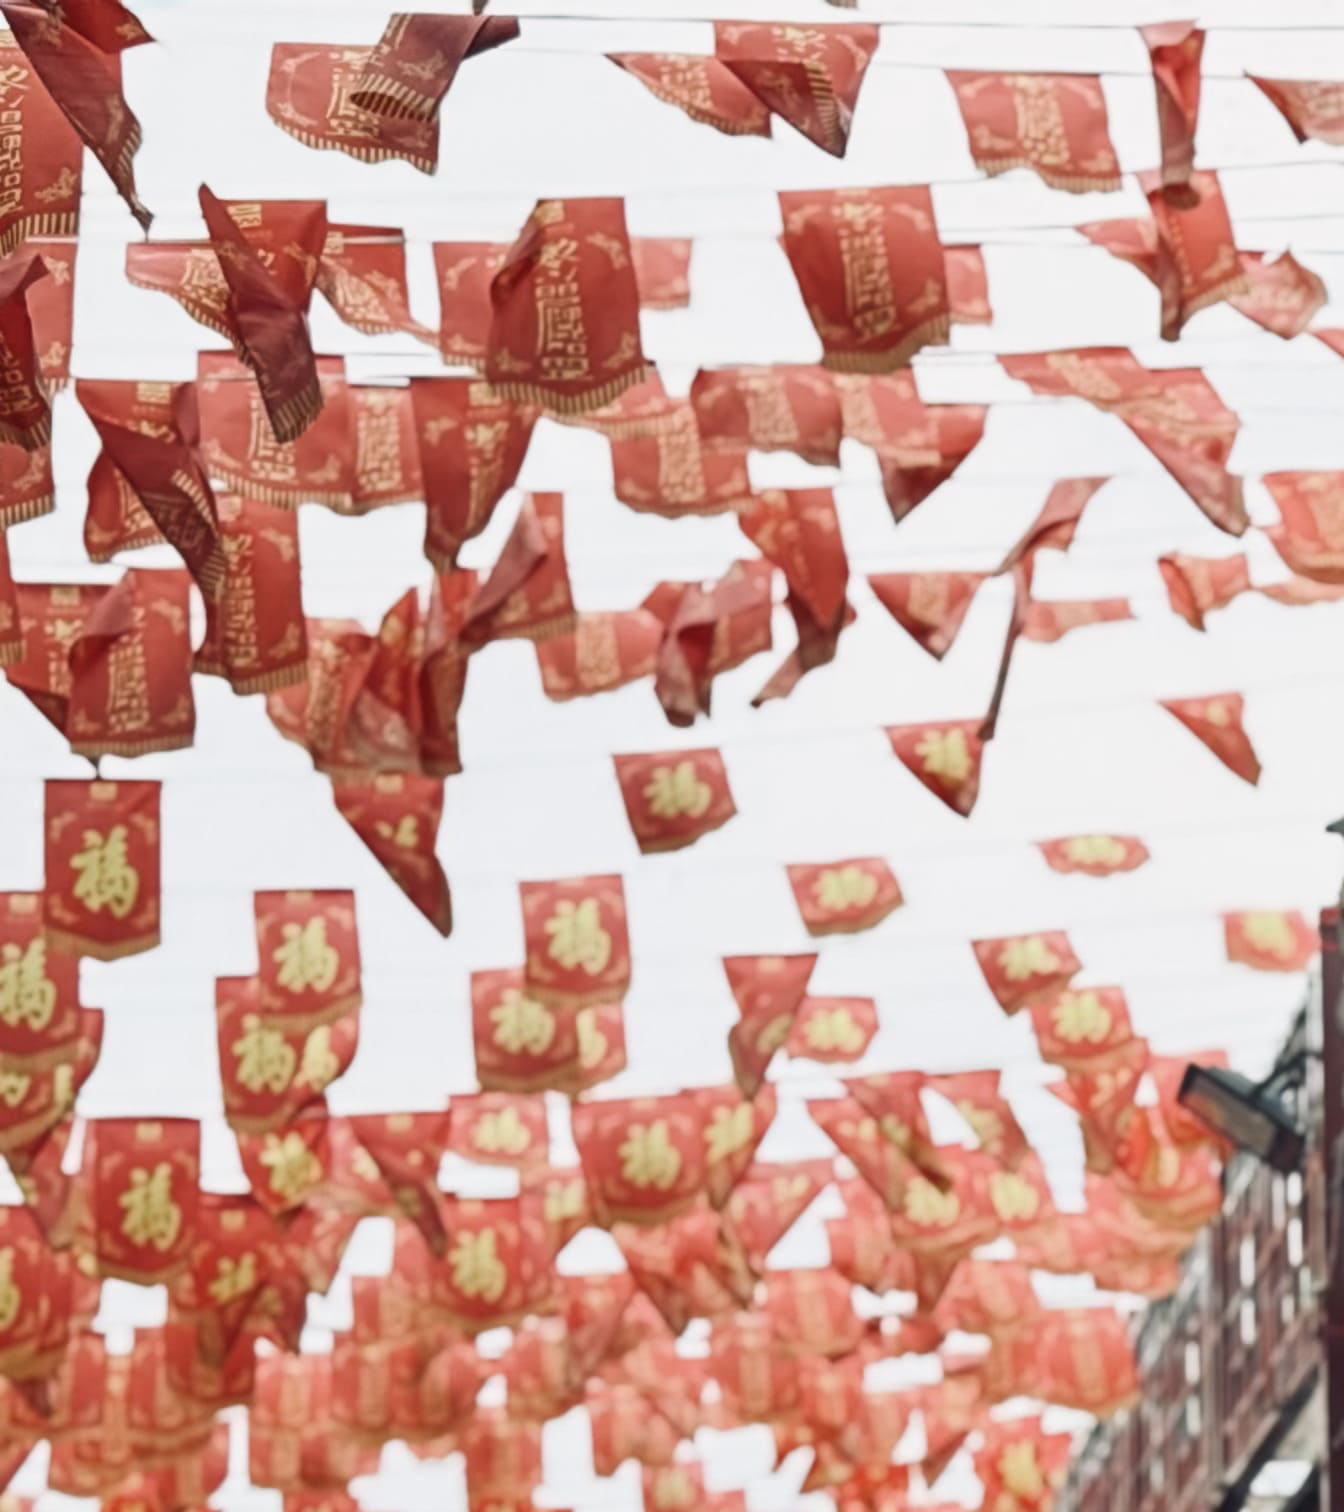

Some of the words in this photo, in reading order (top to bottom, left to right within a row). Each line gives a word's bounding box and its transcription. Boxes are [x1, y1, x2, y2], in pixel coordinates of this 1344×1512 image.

[70, 825, 139, 918] 福
[0, 938, 56, 1031] 福
[273, 916, 339, 993] 福
[232, 1014, 297, 1094] 福
[118, 1162, 182, 1252] 福
